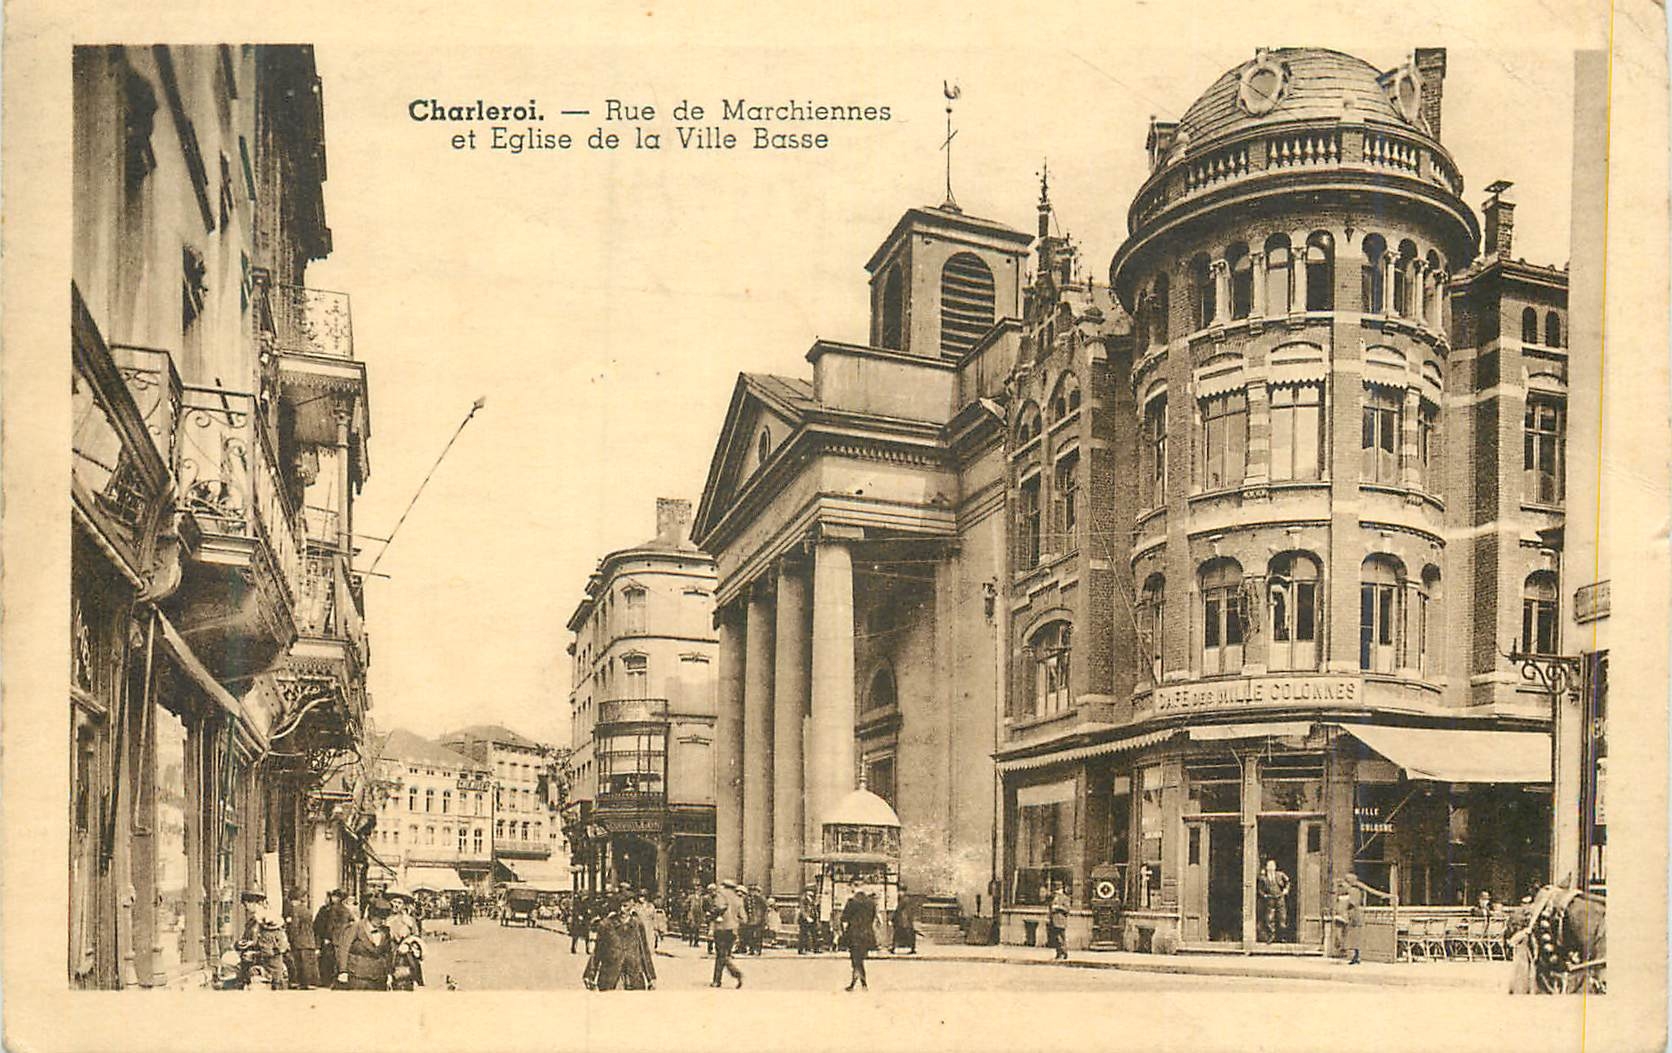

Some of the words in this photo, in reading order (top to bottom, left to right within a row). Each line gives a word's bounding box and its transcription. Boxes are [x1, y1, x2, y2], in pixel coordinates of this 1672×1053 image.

[1192, 691, 1214, 706] DES
[1219, 684, 1263, 703] MILLE
[1270, 682, 1355, 701] COLONNES
